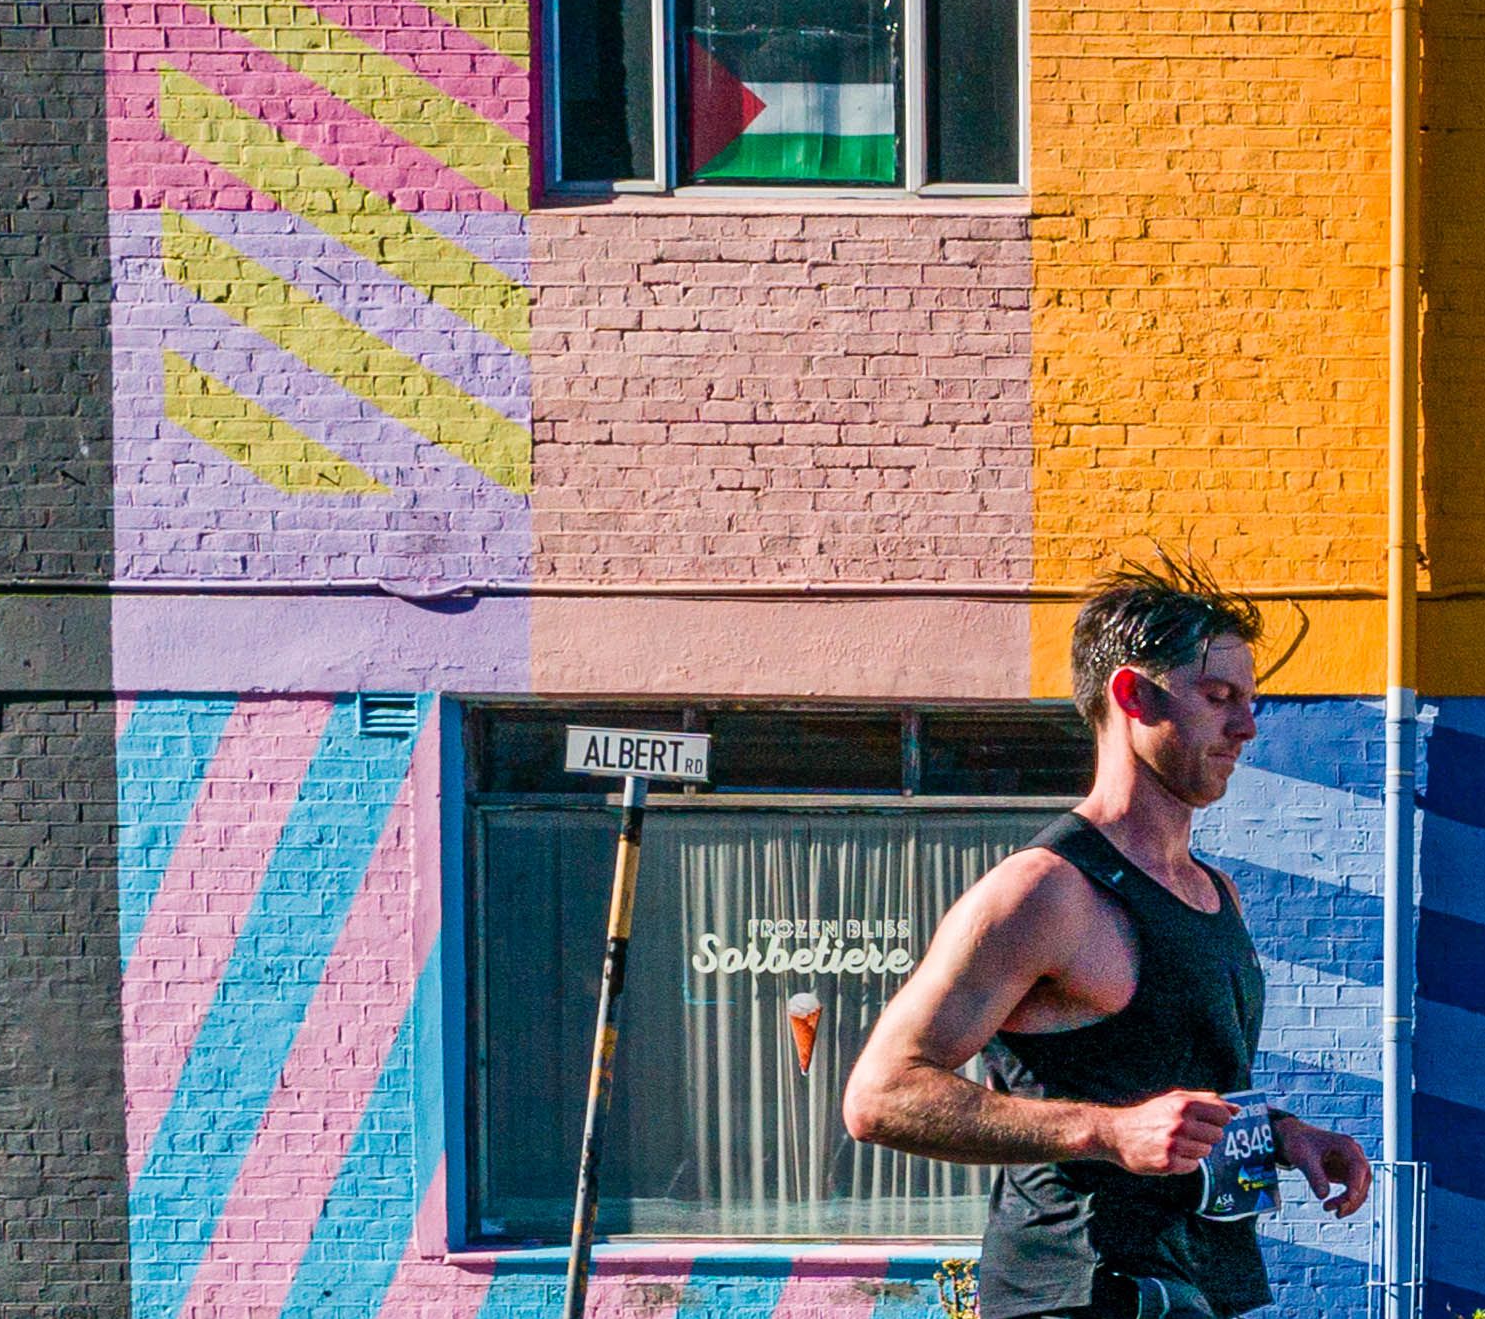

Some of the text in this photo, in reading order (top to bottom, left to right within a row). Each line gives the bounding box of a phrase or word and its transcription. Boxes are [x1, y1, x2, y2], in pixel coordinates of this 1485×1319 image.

[583, 735, 703, 774] ALBERT RD
[748, 919, 910, 939] FROZEN BLISS
[692, 933, 914, 974] Sorbetiere
